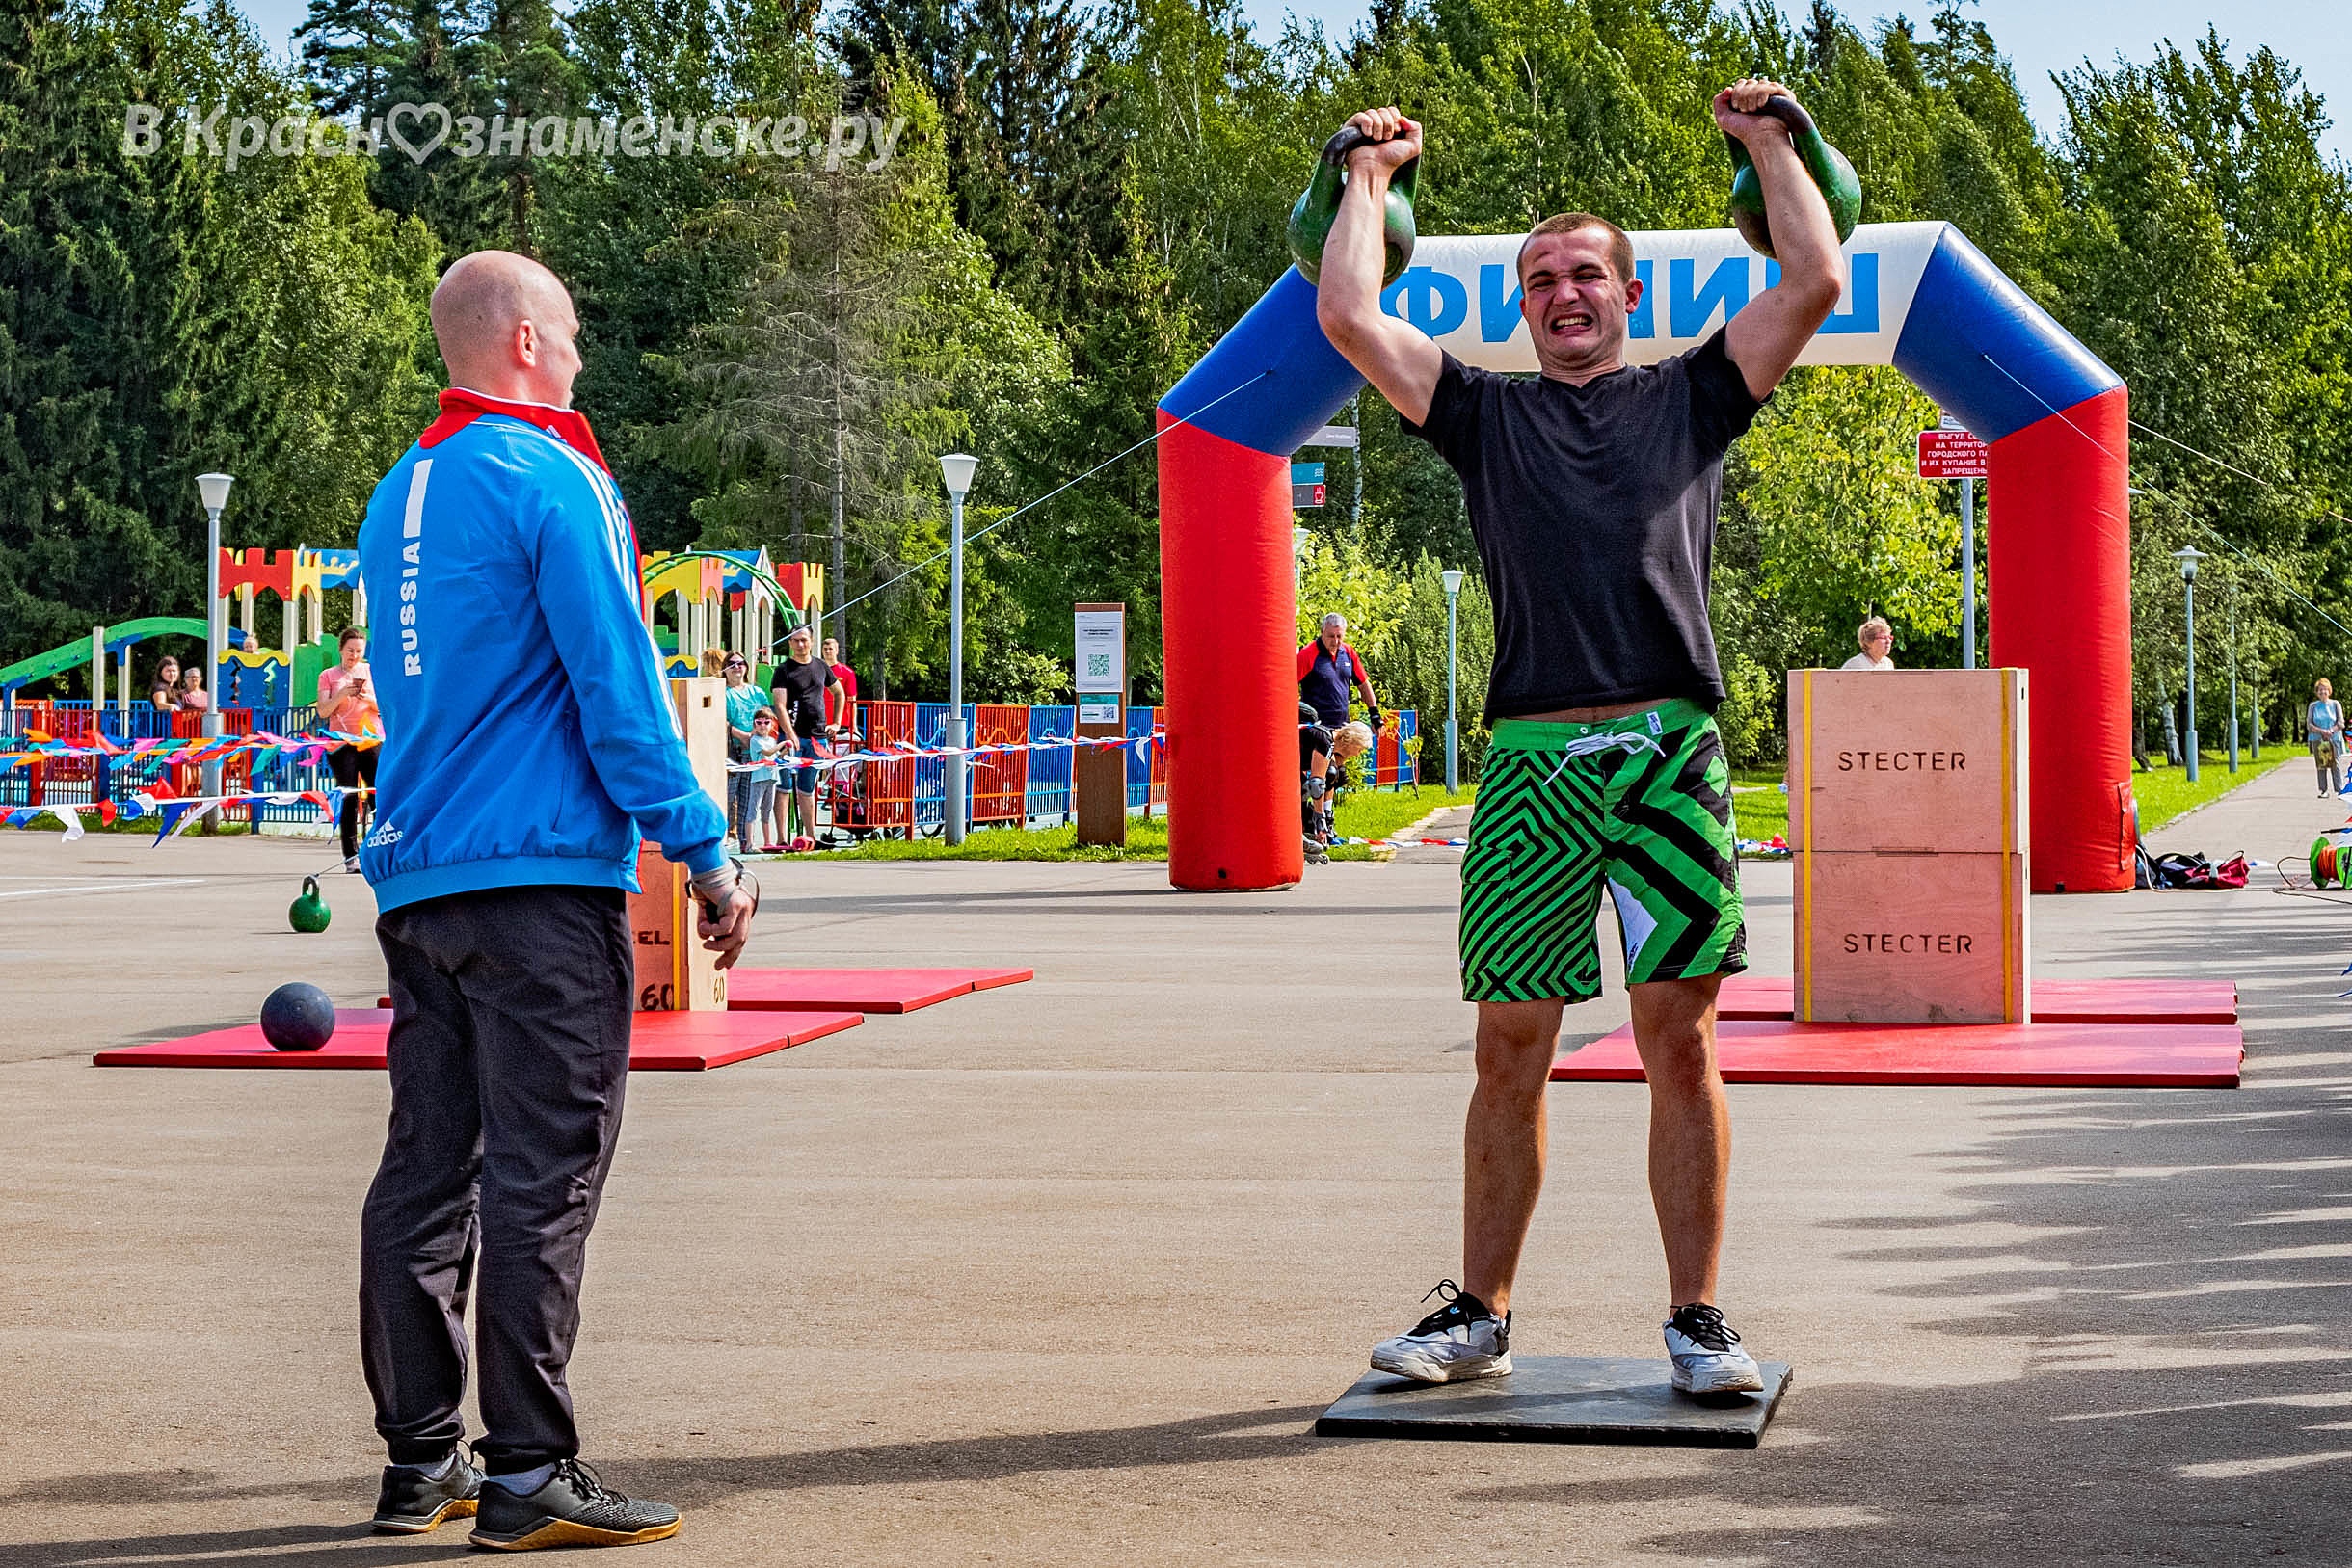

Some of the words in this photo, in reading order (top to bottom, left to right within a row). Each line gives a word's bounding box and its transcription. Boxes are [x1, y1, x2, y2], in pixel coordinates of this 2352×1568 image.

[1927, 450, 1976, 459] ГОРОДСКОГО
[399, 541, 422, 677] RUSSIA
[1838, 751, 1966, 772] STECTER
[632, 929, 671, 946] EL
[1843, 933, 1972, 954] STECTER
[640, 983, 674, 1011] 60
[713, 976, 725, 1004] 60
